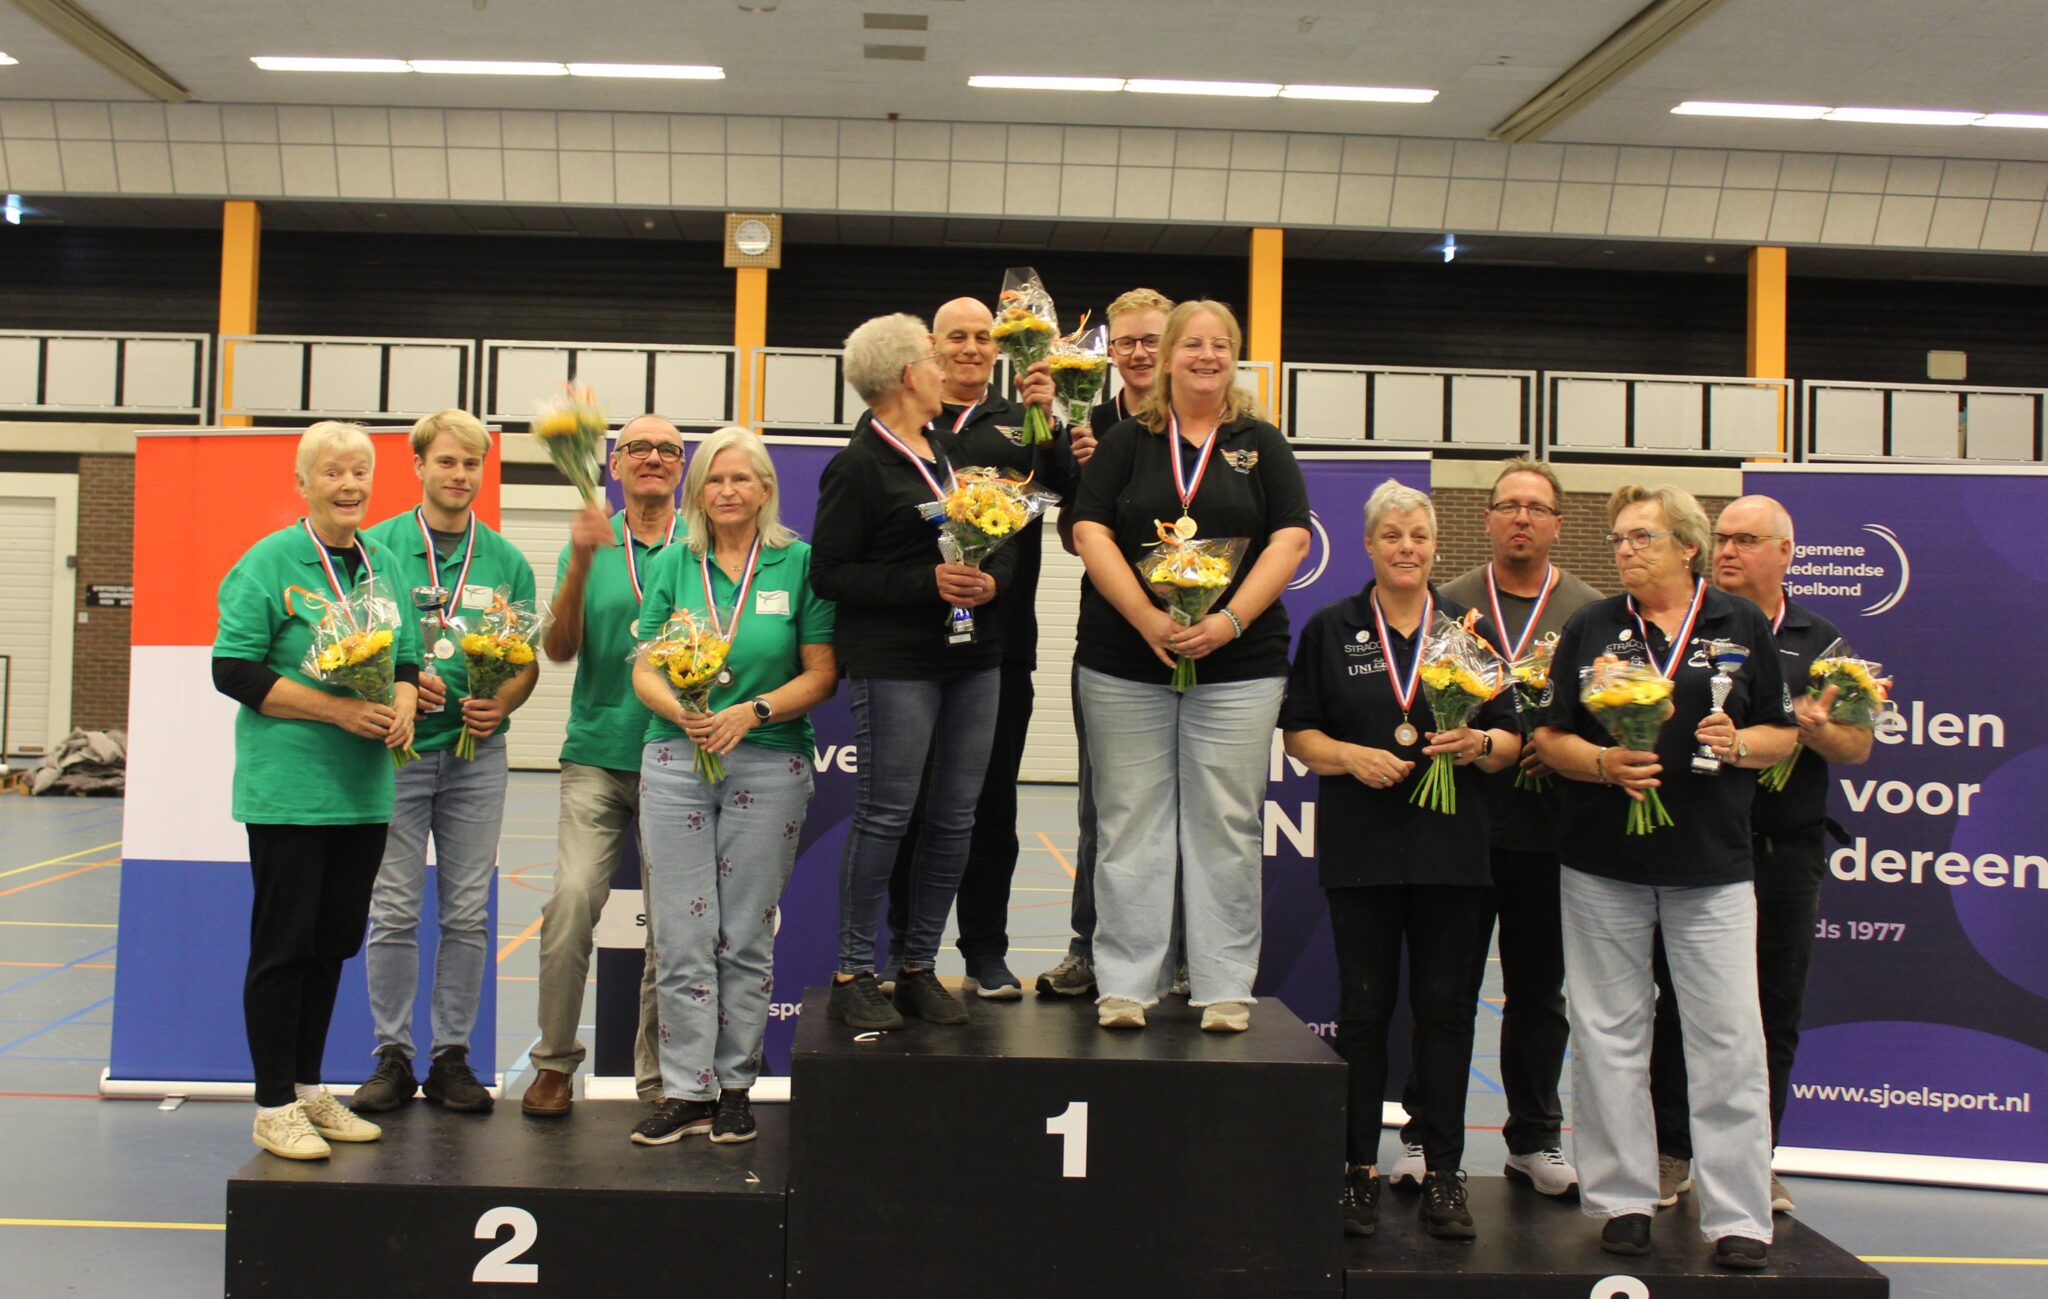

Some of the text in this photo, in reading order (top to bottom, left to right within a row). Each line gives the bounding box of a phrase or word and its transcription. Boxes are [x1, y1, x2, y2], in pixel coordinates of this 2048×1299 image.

[1840, 779, 1981, 816] voor
[1825, 837, 2048, 889] dereen
[1847, 921, 1906, 941] 1977
[1792, 1083, 2030, 1112] www.sjoelsport.nl
[1046, 1102, 1088, 1177] 1
[472, 1206, 538, 1283] 2
